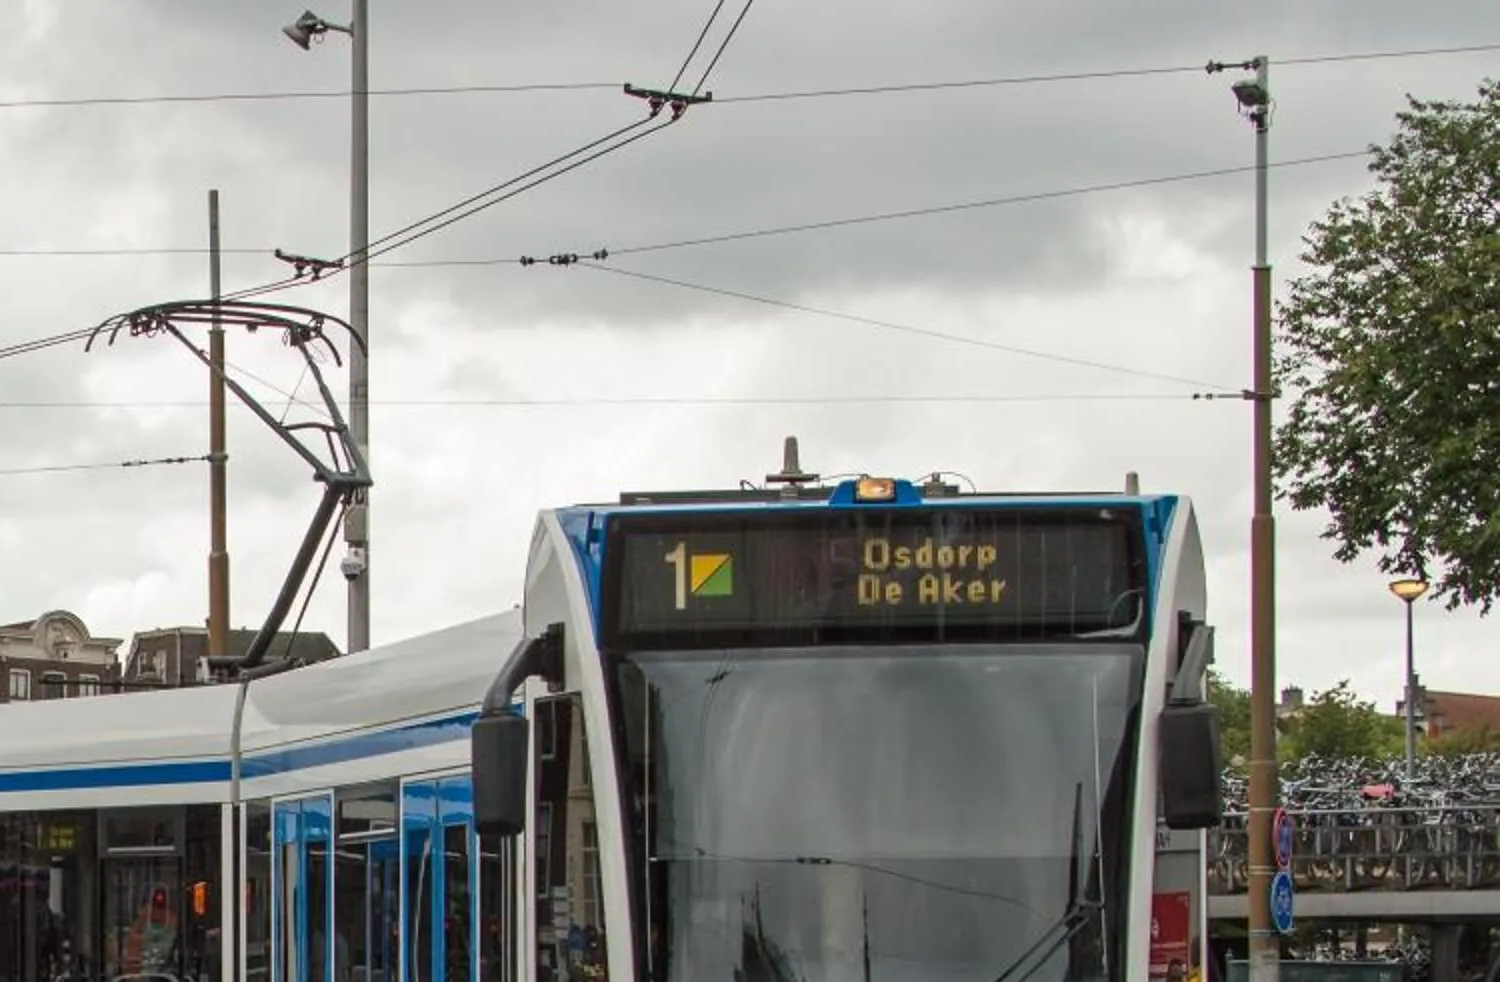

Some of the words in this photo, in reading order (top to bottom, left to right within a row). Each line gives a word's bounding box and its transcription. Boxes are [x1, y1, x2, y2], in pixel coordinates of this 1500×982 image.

[863, 537, 997, 570] Osdorp
[664, 542, 687, 610] 1
[856, 573, 903, 606] De
[918, 572, 1008, 606] Aker
